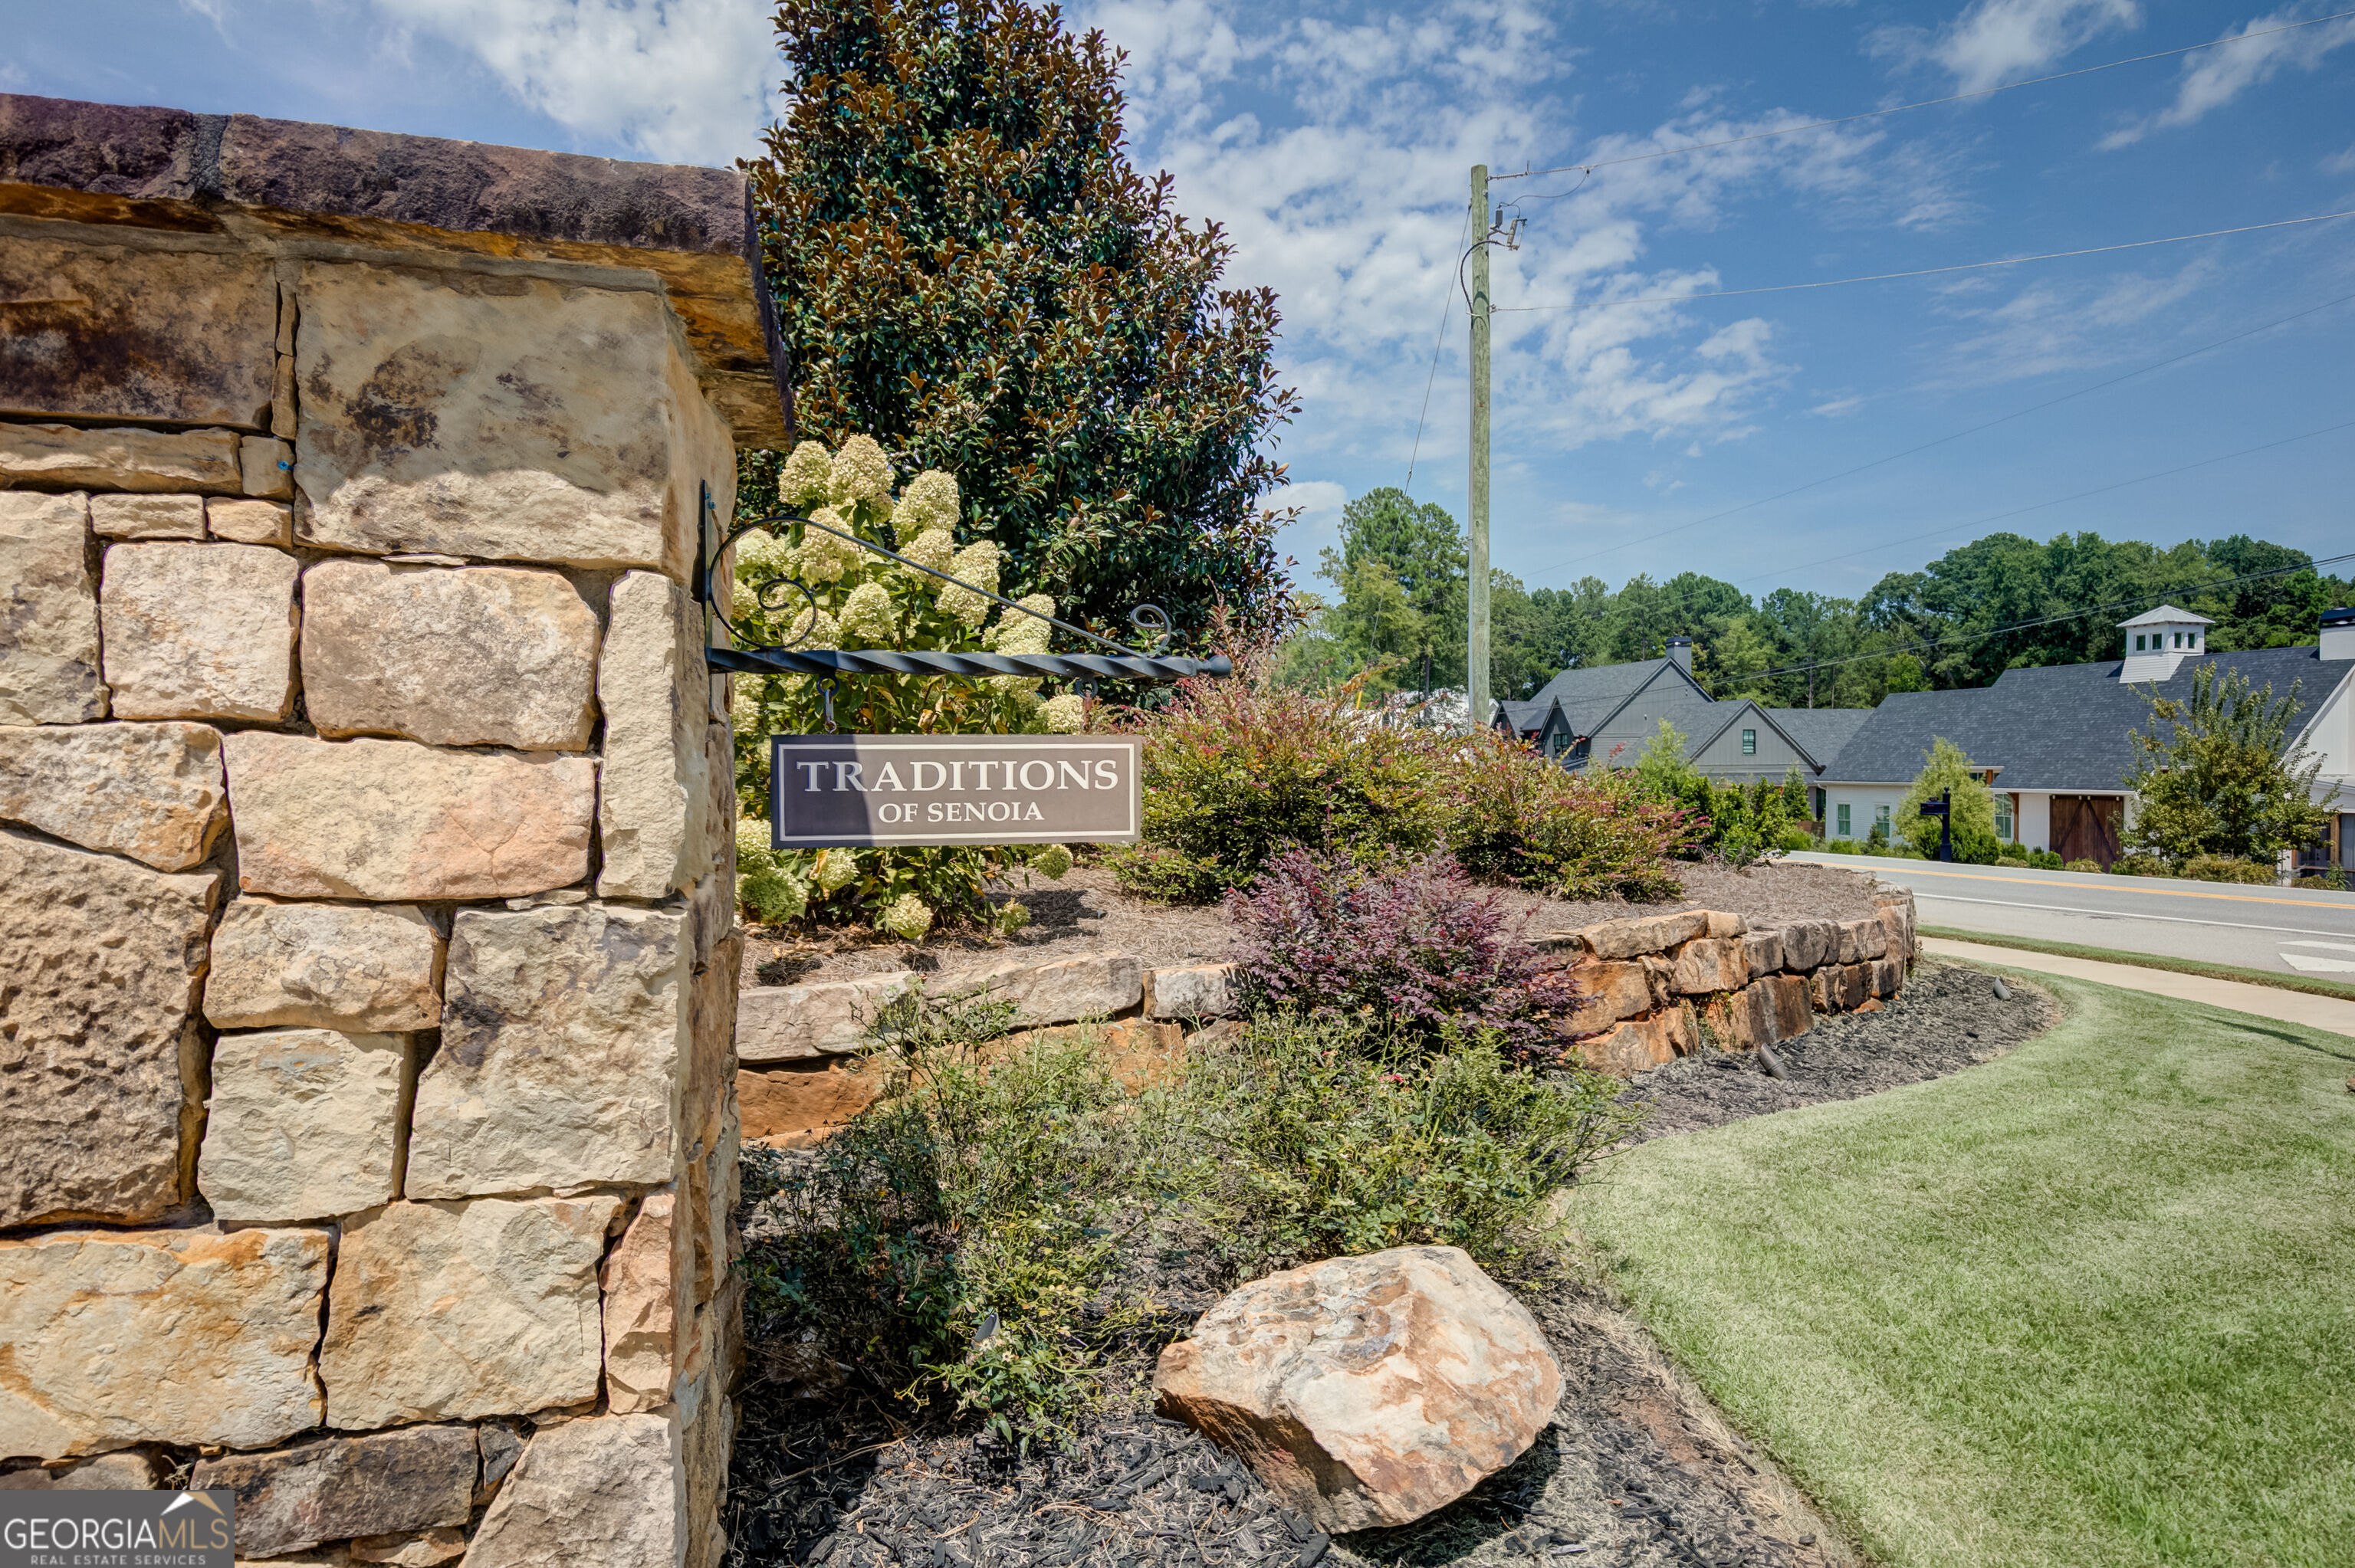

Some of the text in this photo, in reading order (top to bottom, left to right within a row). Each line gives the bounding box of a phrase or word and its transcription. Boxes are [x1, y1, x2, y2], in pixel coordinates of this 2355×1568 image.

[796, 759, 1119, 792] TRADITIONS
[878, 801, 1046, 824] OF SENOIA
